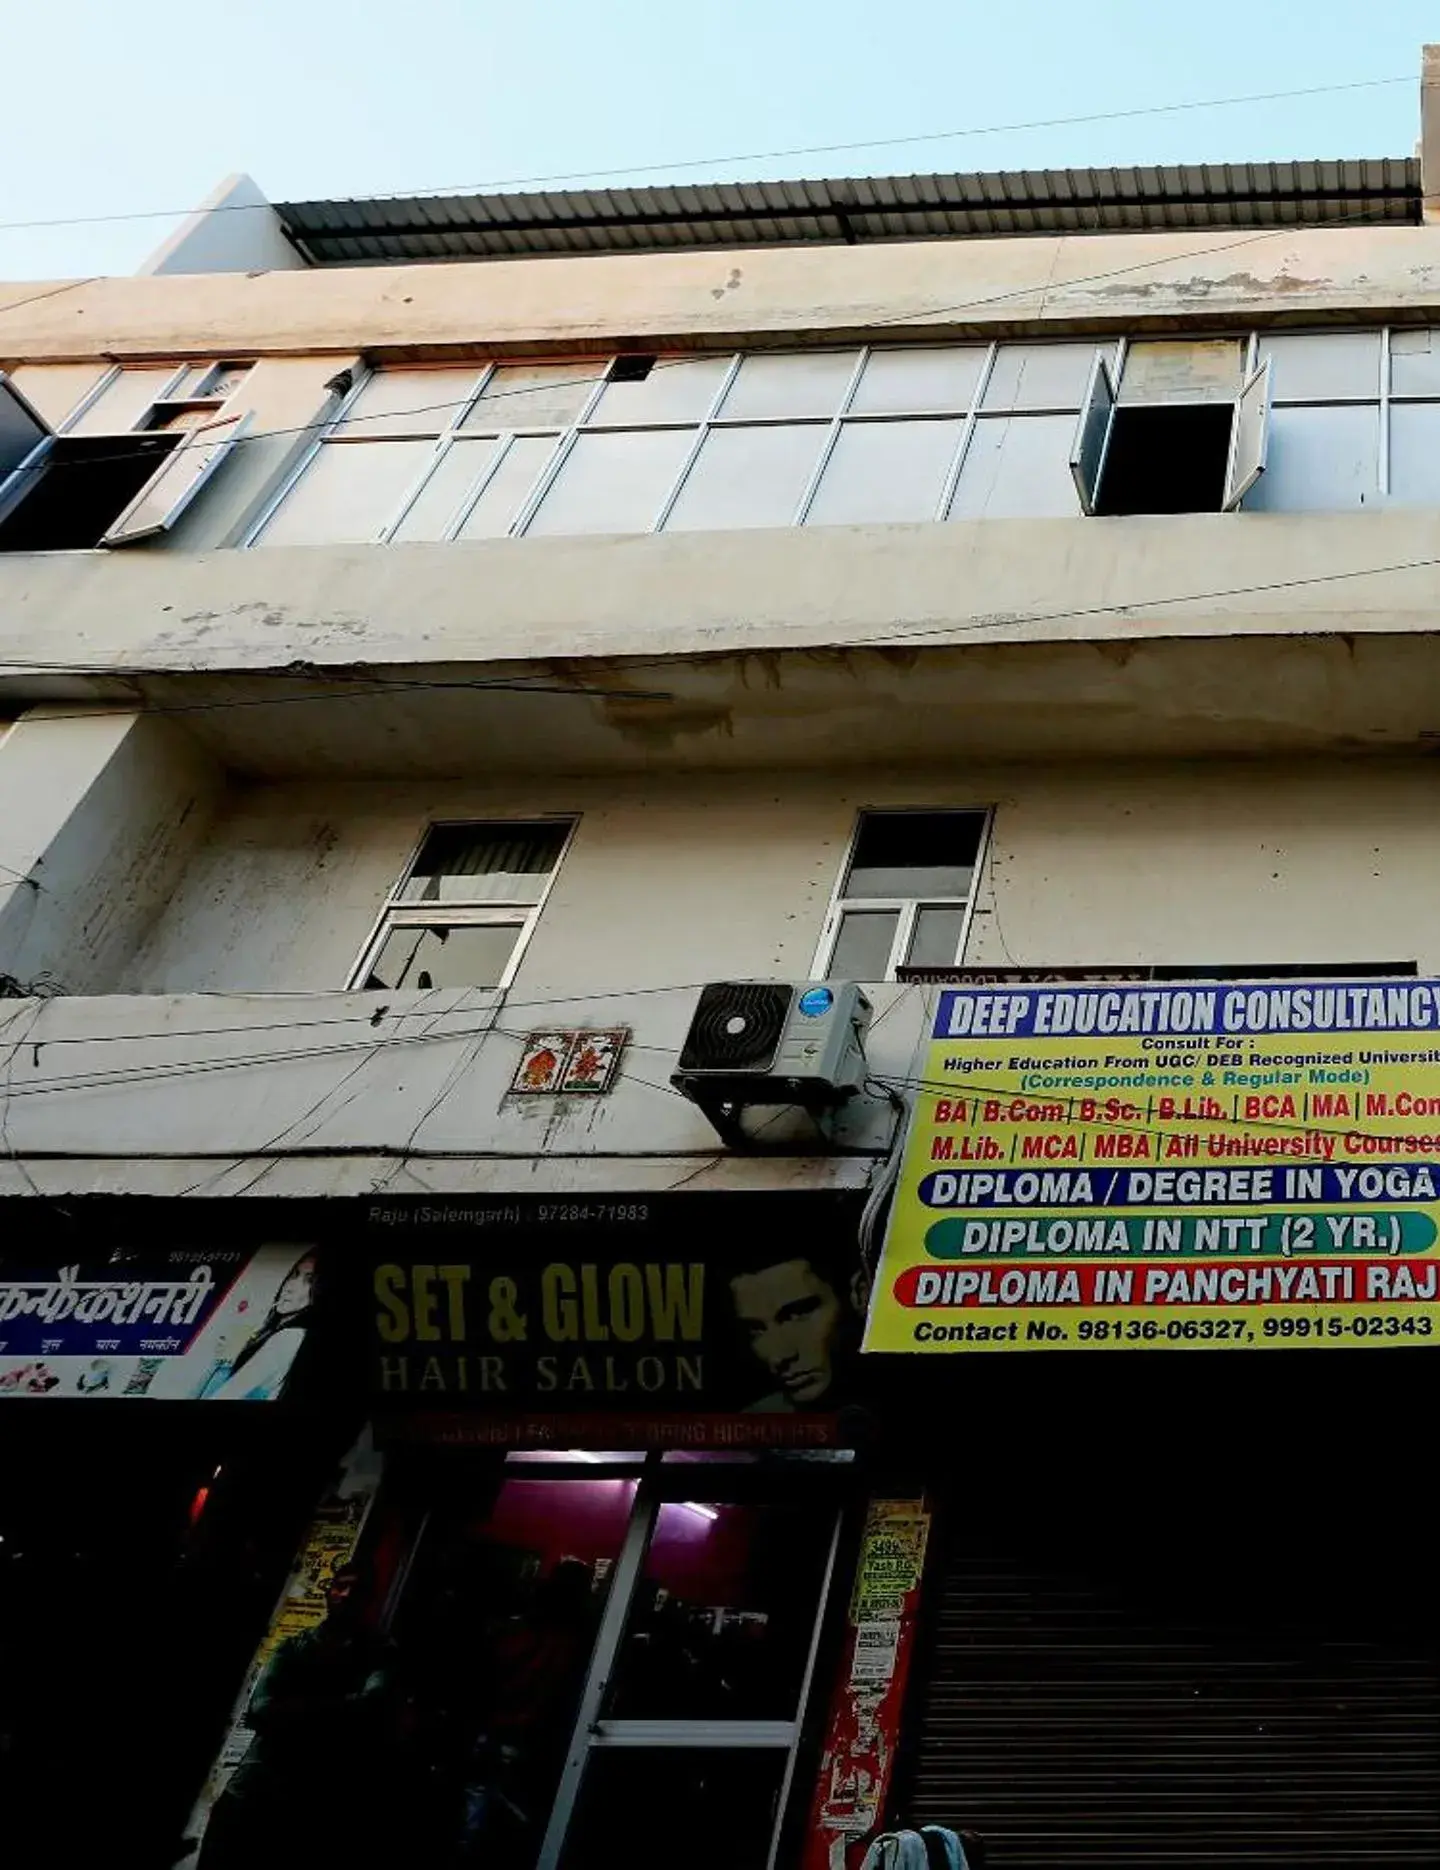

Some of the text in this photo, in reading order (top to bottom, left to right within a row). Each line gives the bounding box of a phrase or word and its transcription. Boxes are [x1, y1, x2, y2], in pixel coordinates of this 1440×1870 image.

[949, 995, 1030, 1035] DEEP
[1033, 990, 1216, 1034] EDUCATION
[1142, 1037, 1210, 1051] Consult
[1216, 1037, 1244, 1050] For
[944, 1057, 1002, 1074] Higher
[1008, 1055, 1098, 1071] Education
[1105, 1054, 1149, 1069] From
[1207, 1053, 1243, 1067] DEB
[1250, 1052, 1352, 1068] Recognized
[1021, 1069, 1370, 1092] (Correspondence & Regular Mode)
[1164, 1133, 1199, 1158] All
[1208, 1131, 1336, 1161] University
[931, 1171, 1093, 1204] DIPLOMA
[1127, 1169, 1273, 1203] DEGREE
[1286, 1168, 1322, 1200] IN
[1334, 1167, 1437, 1200] YOGA
[367, 1204, 409, 1227] Raju
[961, 1215, 1401, 1256] DIPLOMA IN NTT (2 YR.)
[915, 1265, 1438, 1305] DIPLOMA IN PANCHYATI RAJ
[372, 1261, 707, 1344] SET & GLOW
[913, 1316, 1433, 1343] Contact No. 98136-06327, 99915-02343
[379, 1354, 706, 1393] HAIR SALON
